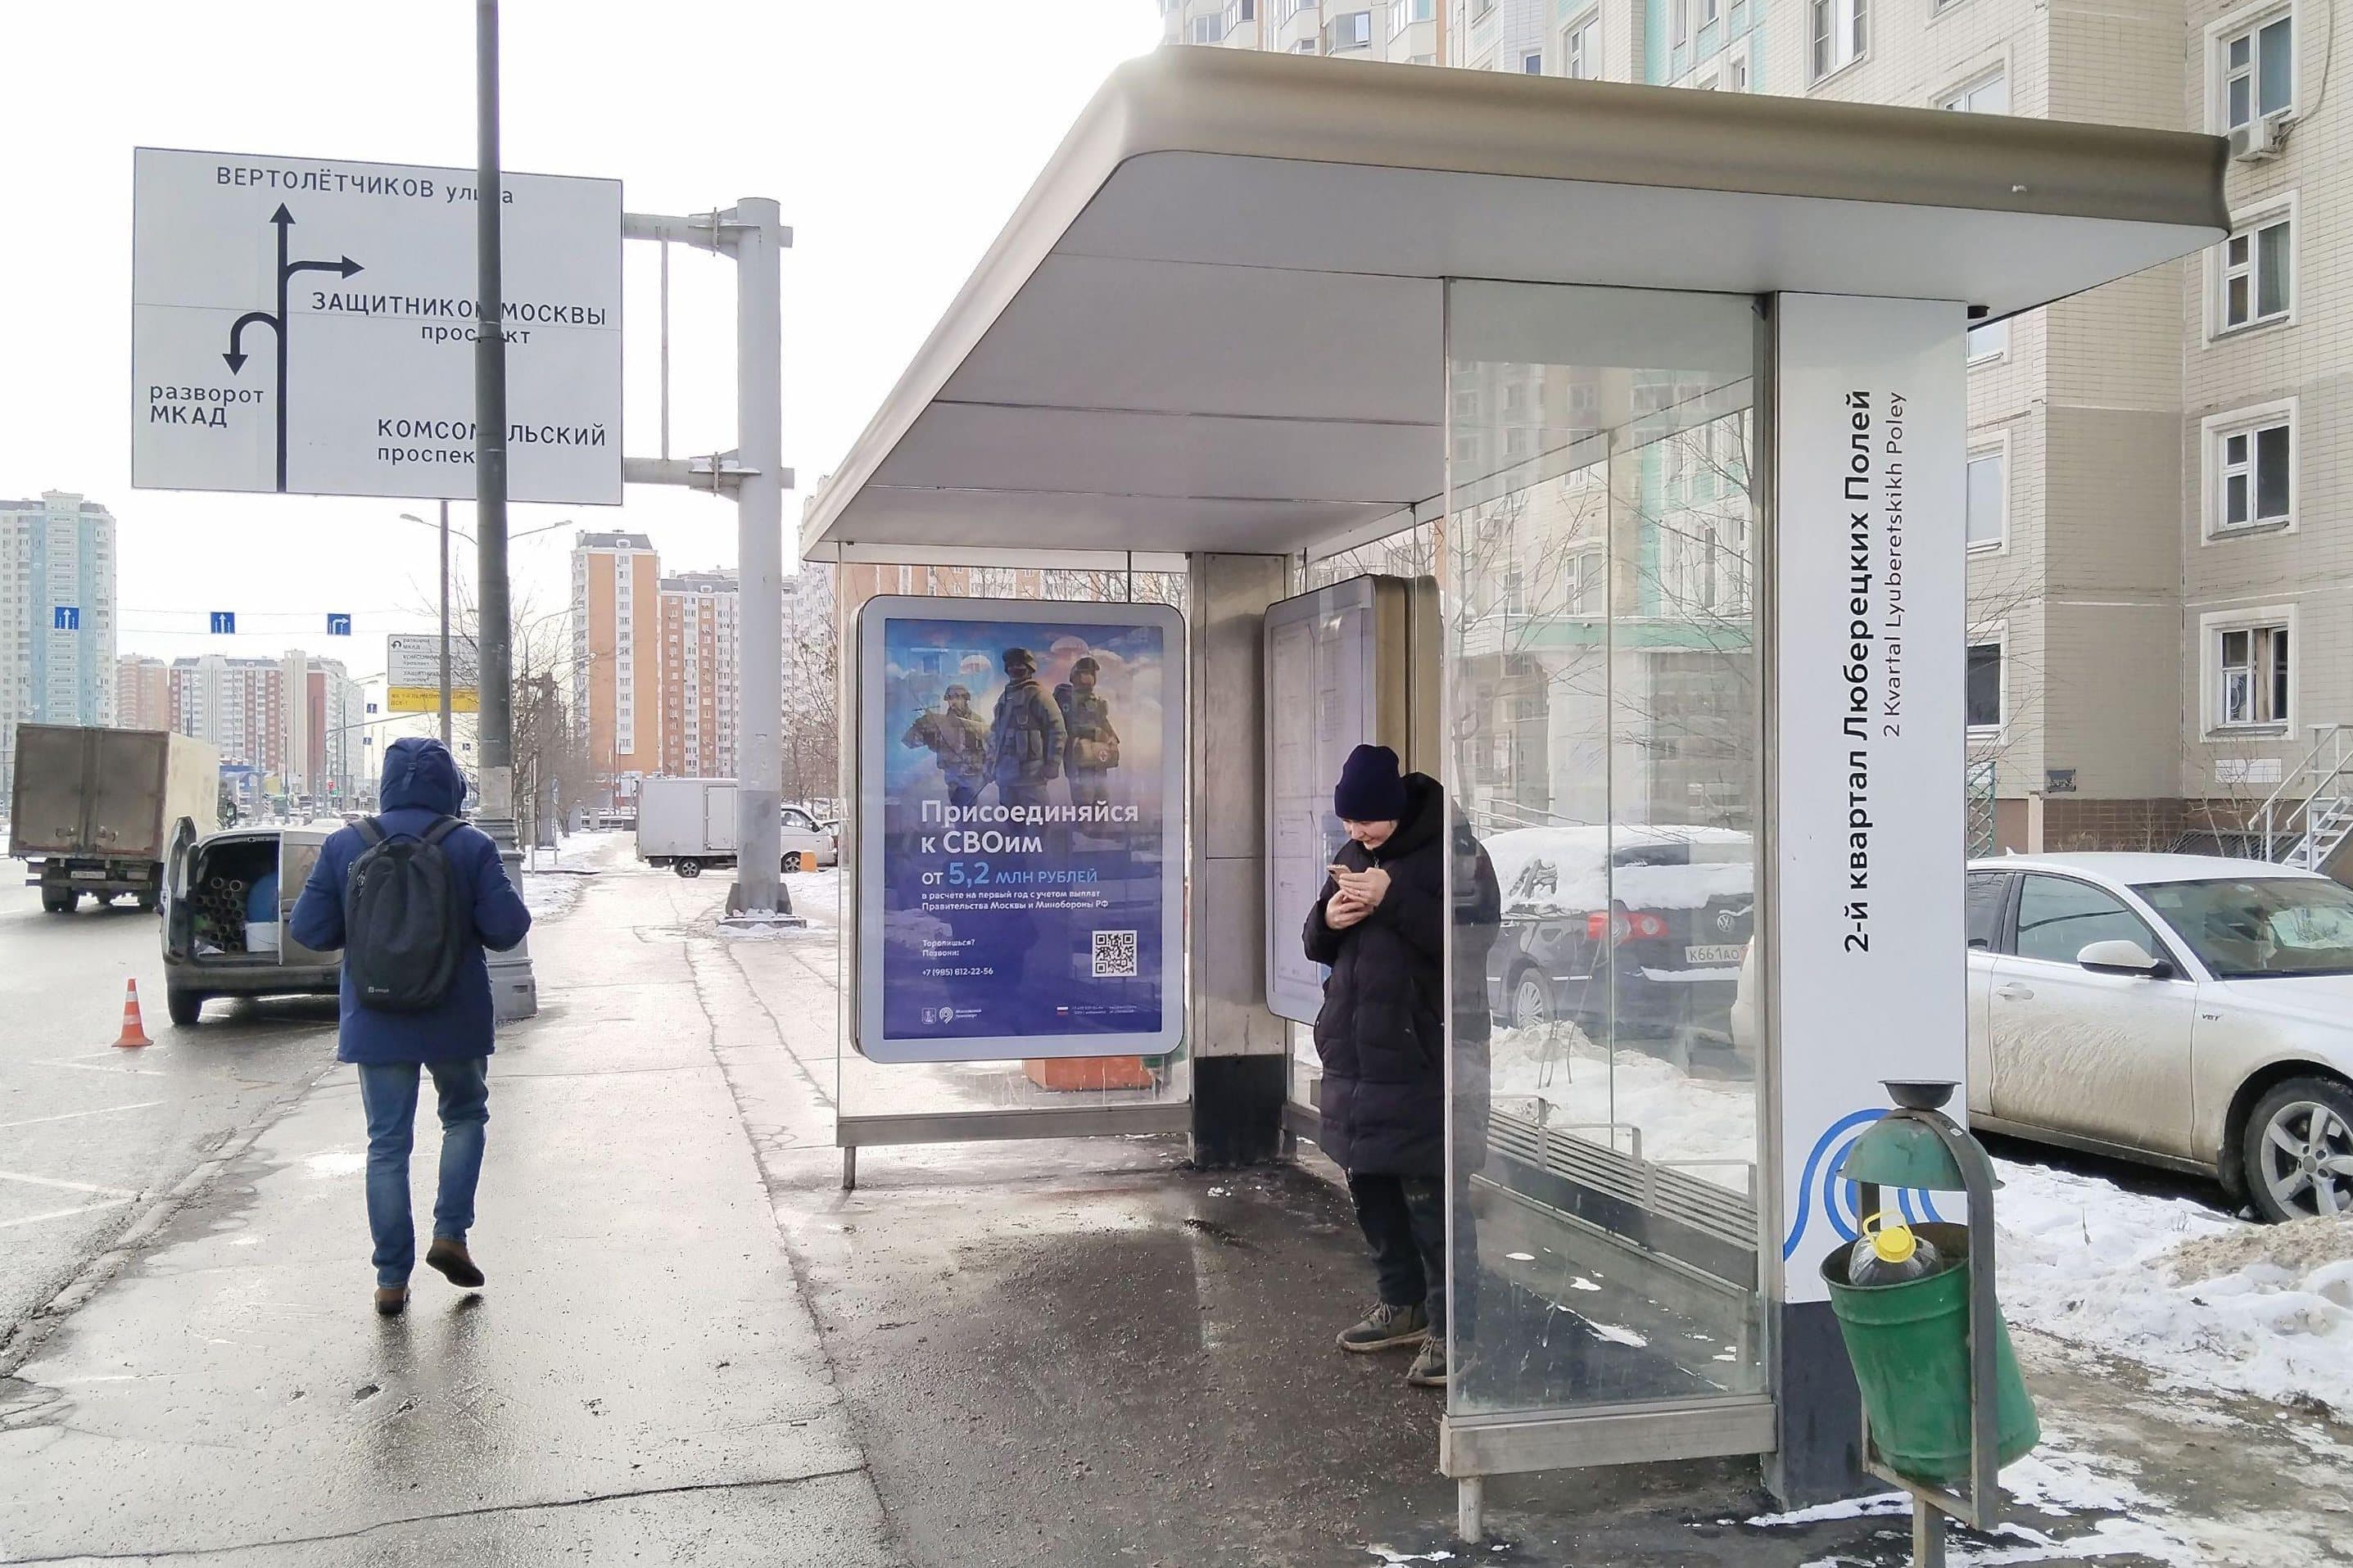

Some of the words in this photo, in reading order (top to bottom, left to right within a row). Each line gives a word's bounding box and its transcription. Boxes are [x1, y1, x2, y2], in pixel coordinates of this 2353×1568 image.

[216, 166, 434, 197] ВЕРТОЛЁТЧИКОВ
[446, 186, 514, 204] ула
[312, 291, 479, 319] ЗАЩИТНИКО
[501, 302, 606, 325] МОСКВЫ
[421, 326, 531, 345] проскт
[150, 386, 265, 408] разворот
[150, 404, 228, 428] МКАД
[1885, 391, 1907, 454] Poley
[378, 418, 606, 447] КОМСОЛЬСКИЙ
[1844, 391, 1871, 500] Полей
[378, 447, 476, 466] проспек
[1883, 463, 1906, 627] Lyuberetskikh
[1842, 512, 1875, 741] Люберецких
[1883, 636, 1902, 716] Kvartal
[1883, 724, 1900, 737] 2
[921, 799, 1138, 829] Присоединяйся
[1848, 751, 1874, 890] квартал
[921, 836, 936, 853] к
[943, 830, 1043, 854] СВОим
[948, 861, 990, 888] 5,2
[1038, 868, 1098, 883] РУБЛЕЙ
[921, 902, 989, 912] Правительства
[990, 901, 1026, 910] Москвы
[1034, 900, 1094, 911] Минобороны
[1095, 900, 1109, 908] РФ
[929, 892, 965, 901] расчете
[978, 890, 1012, 900] первый
[1036, 891, 1068, 900] учетом
[1069, 890, 1101, 898] выплат
[1844, 901, 1869, 953] 2-й
[922, 938, 975, 948] Торопишься?
